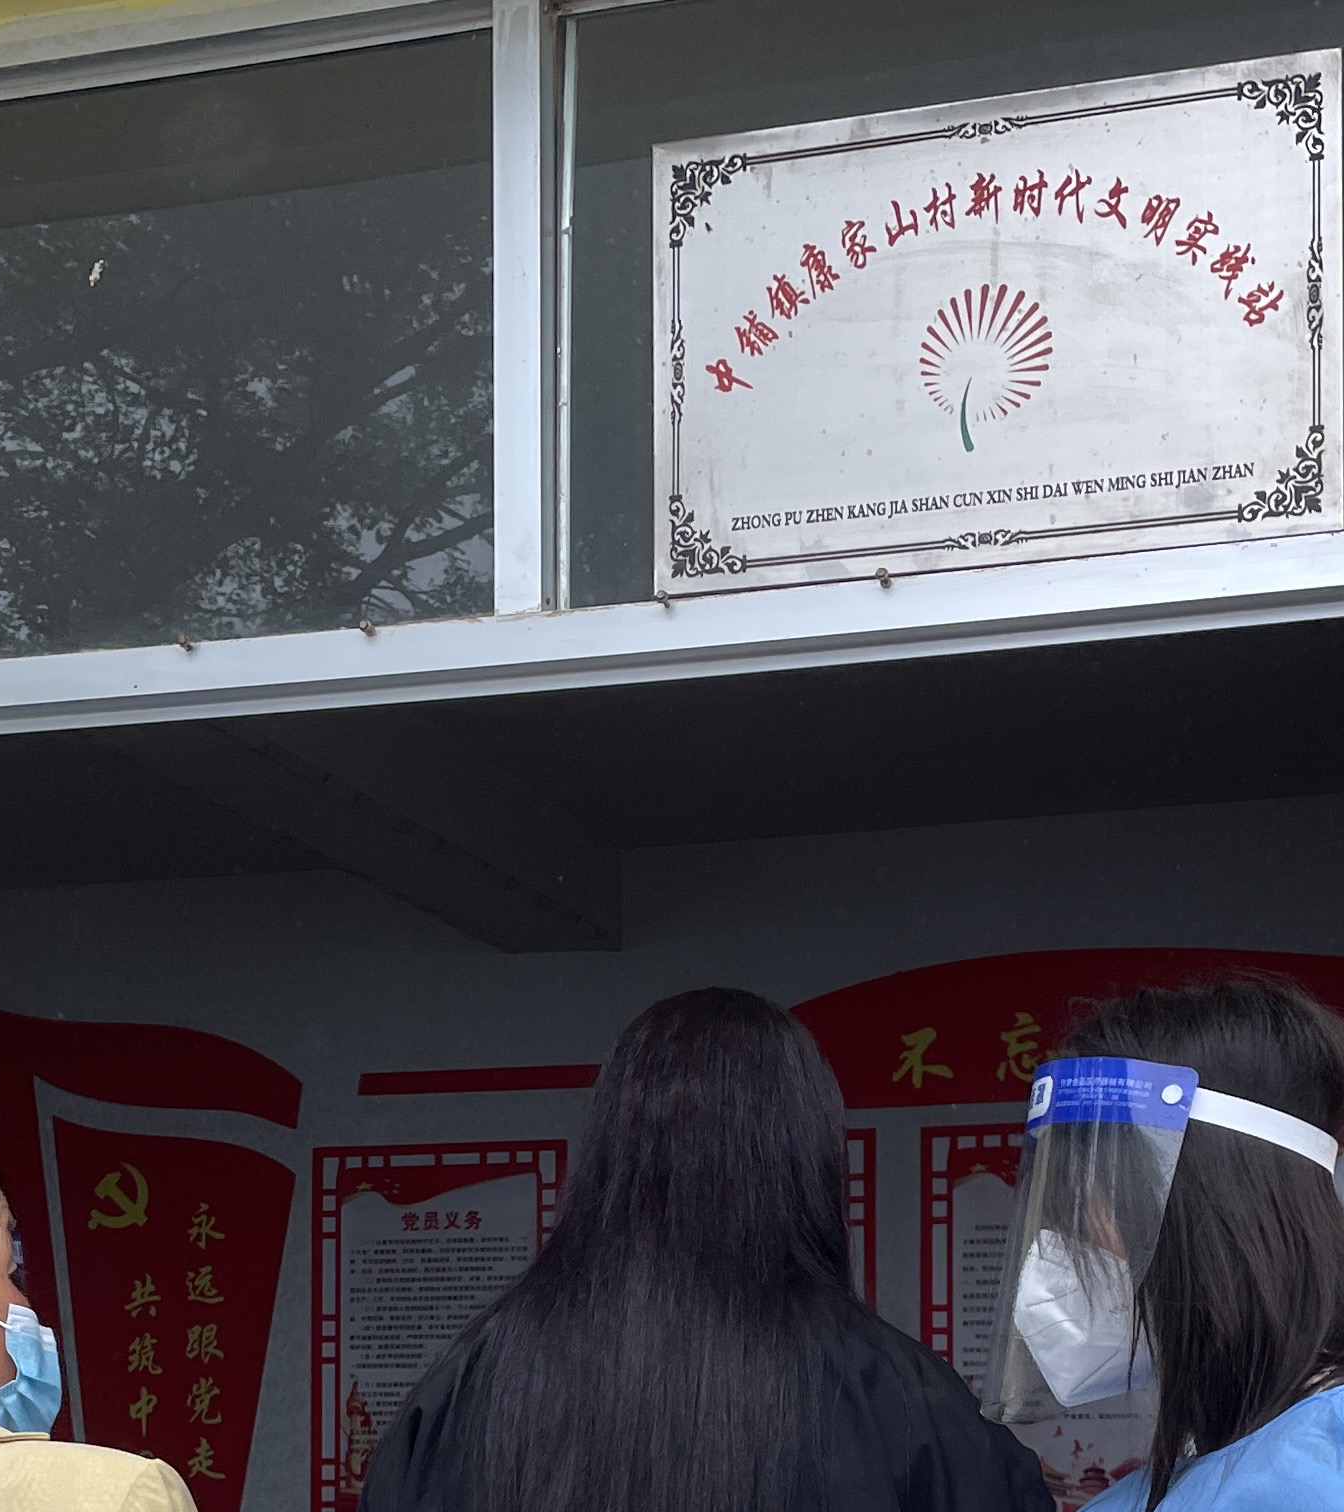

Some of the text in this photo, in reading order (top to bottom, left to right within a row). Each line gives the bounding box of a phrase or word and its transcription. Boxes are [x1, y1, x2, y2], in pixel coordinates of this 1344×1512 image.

[732, 462, 1255, 531] ZHONG PU ZHEN KANG JIA SHAN CUN XIN SHI DAI WEN MING SHI JIAN ZHAN
[401, 1210, 482, 1231] 党员义务
[124, 1273, 163, 1458] 共筑中
[185, 1203, 226, 1479] 永远跟党走
